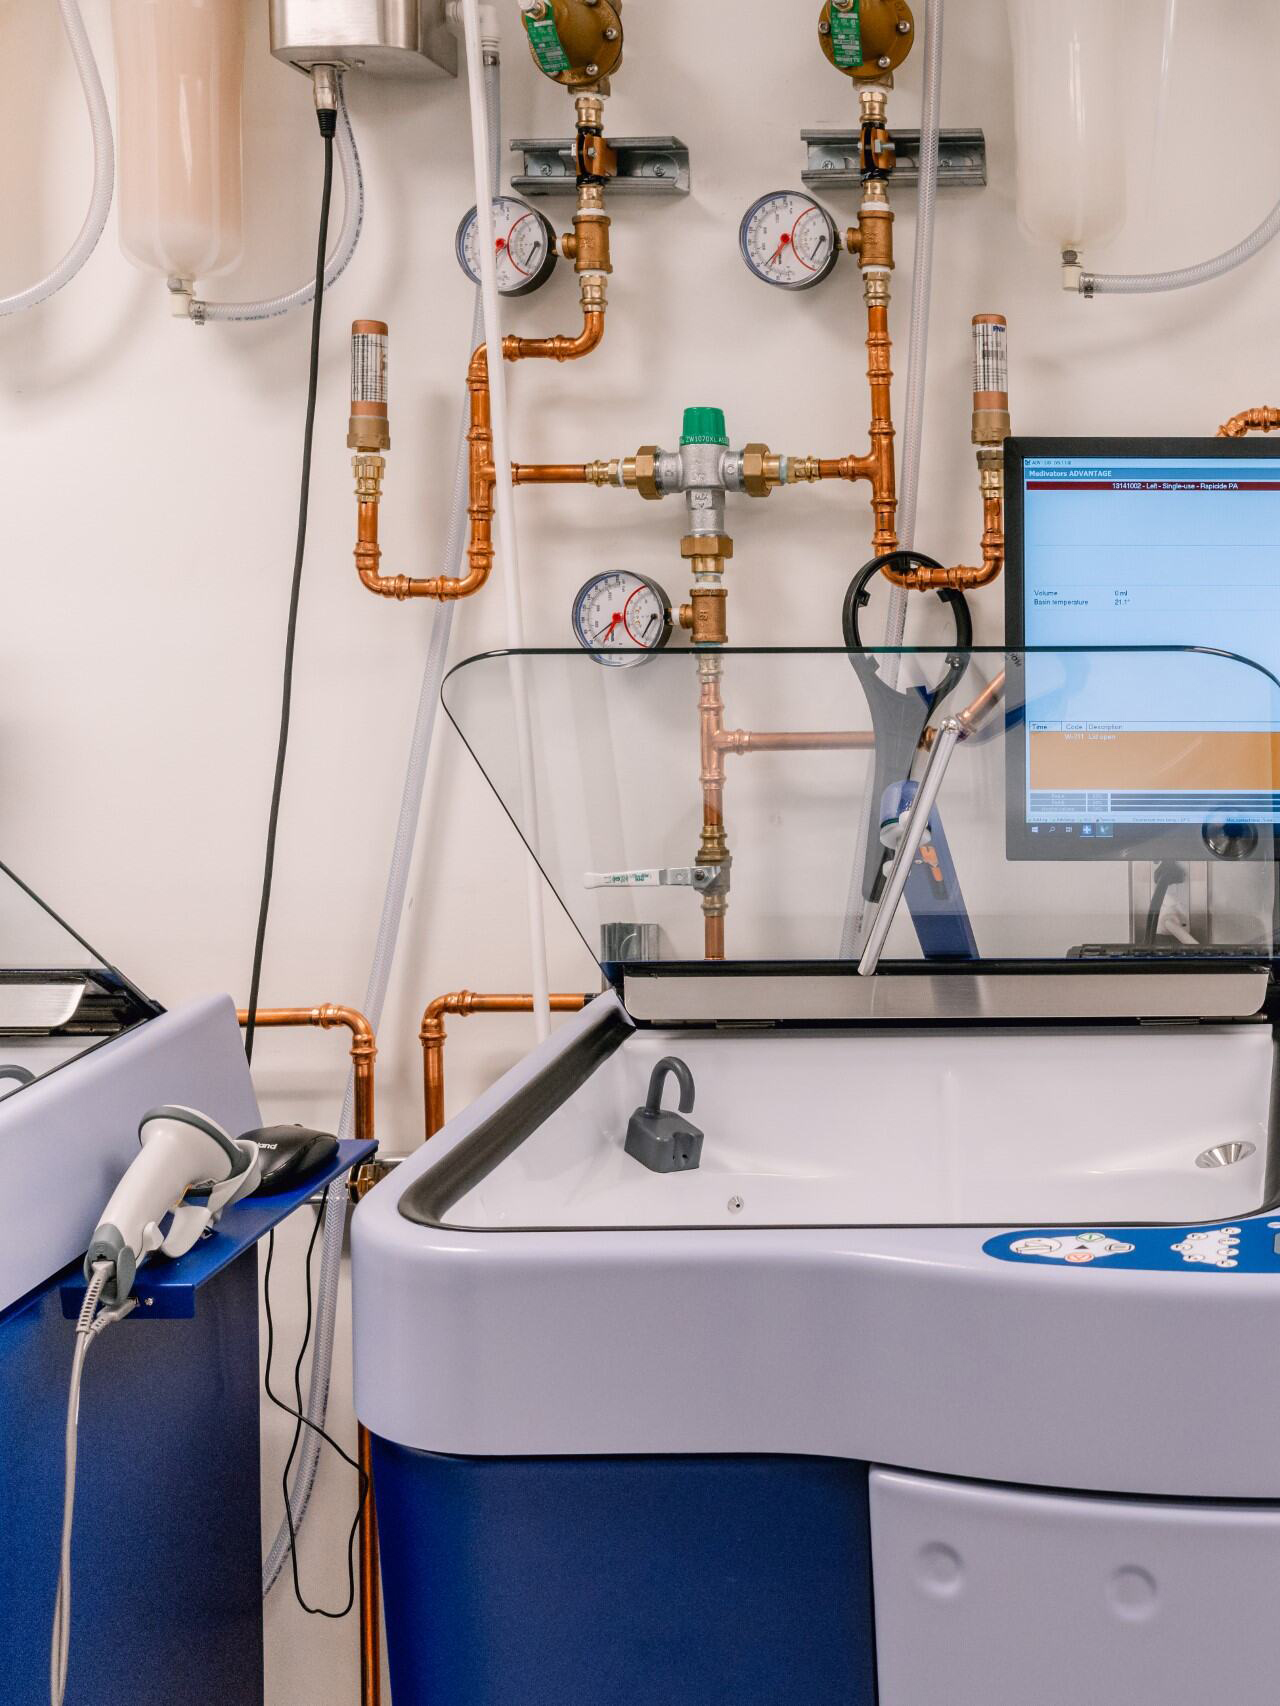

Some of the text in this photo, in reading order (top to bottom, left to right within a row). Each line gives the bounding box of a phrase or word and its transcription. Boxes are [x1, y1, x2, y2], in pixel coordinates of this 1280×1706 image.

[1162, 483, 1195, 491] Single-use
[1200, 483, 1228, 491] Rapicide
[1053, 599, 1089, 607] temperature
